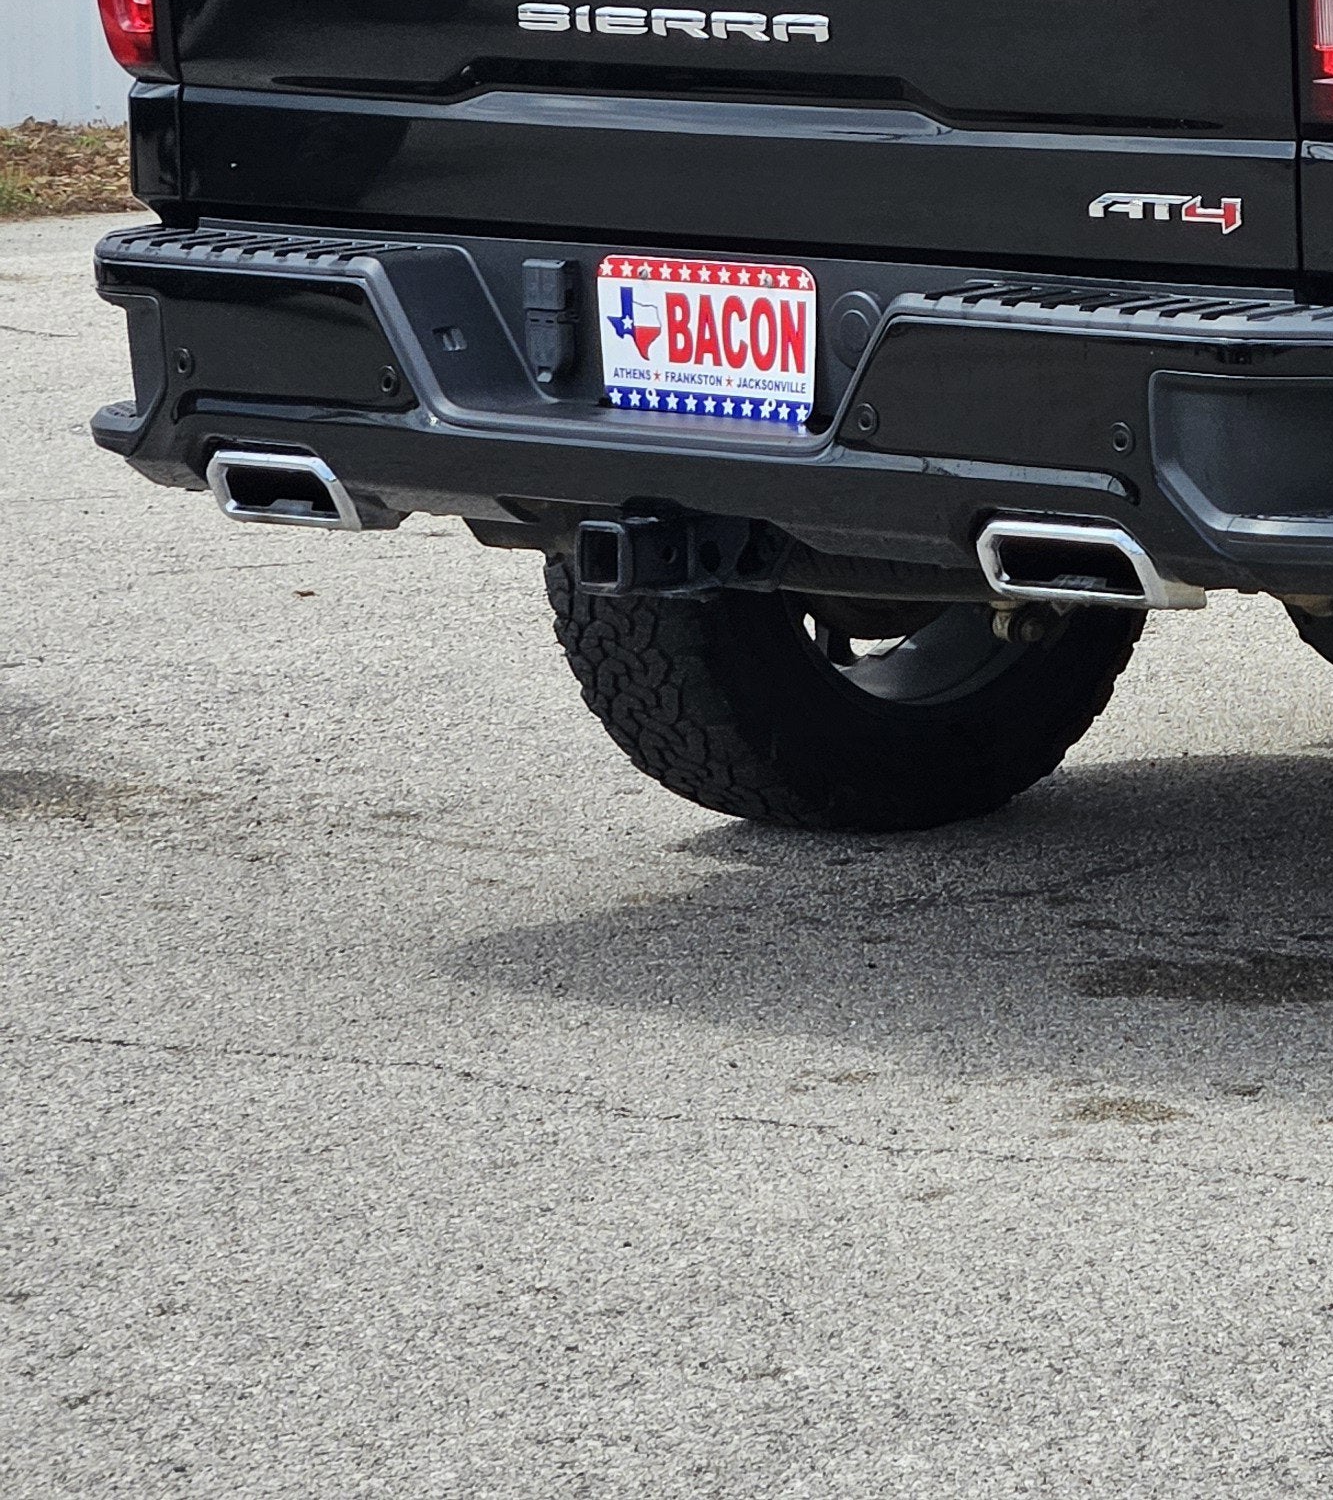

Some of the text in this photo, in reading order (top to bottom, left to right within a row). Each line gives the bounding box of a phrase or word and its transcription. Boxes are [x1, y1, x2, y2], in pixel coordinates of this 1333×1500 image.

[517, 3, 831, 43] SIERRA
[1088, 192, 1243, 235] AT4
[664, 291, 807, 375] BACON
[613, 366, 807, 395] ATHENS FRANKSTON JACKSONVILLE
